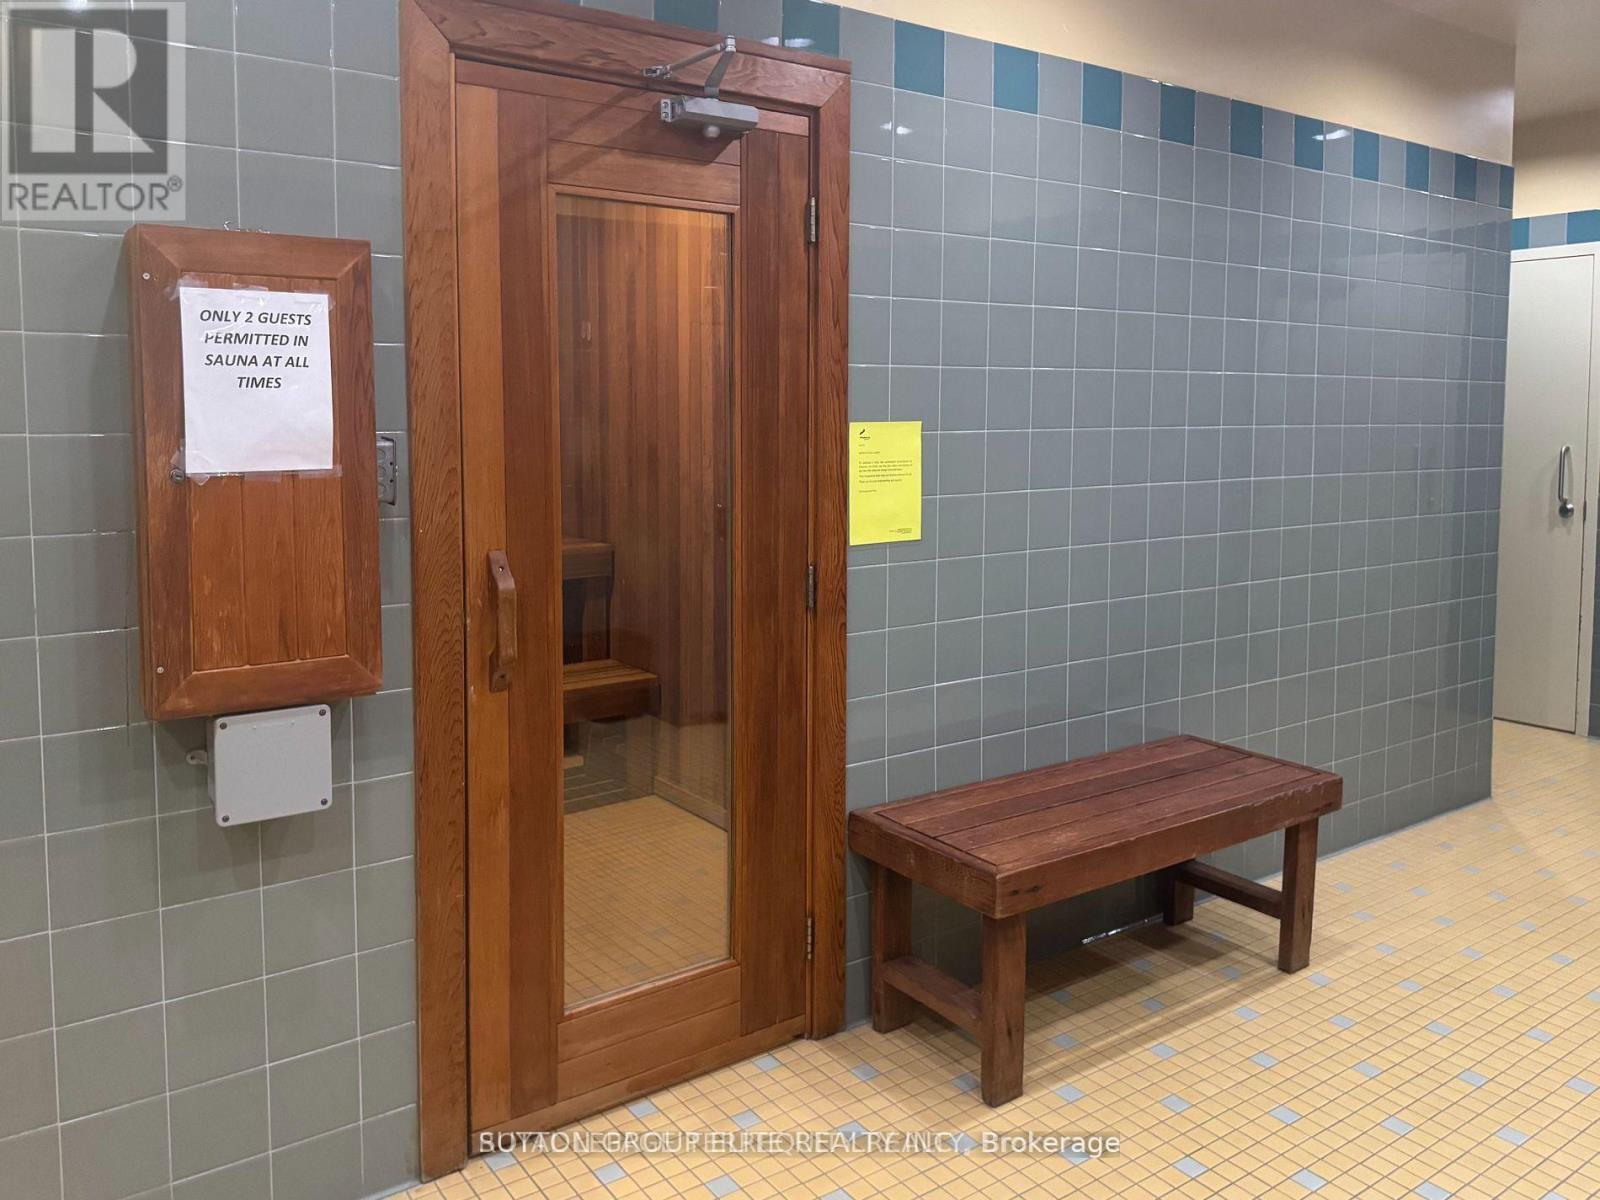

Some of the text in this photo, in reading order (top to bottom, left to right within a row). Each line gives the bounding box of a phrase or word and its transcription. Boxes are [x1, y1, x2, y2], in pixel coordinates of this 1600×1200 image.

[199, 309, 312, 326] ONLY 2 GUESTS
[204, 332, 309, 347] PERMITTED IN
[204, 354, 310, 368] SAUNA AT ALL
[237, 376, 282, 389] TIMES
